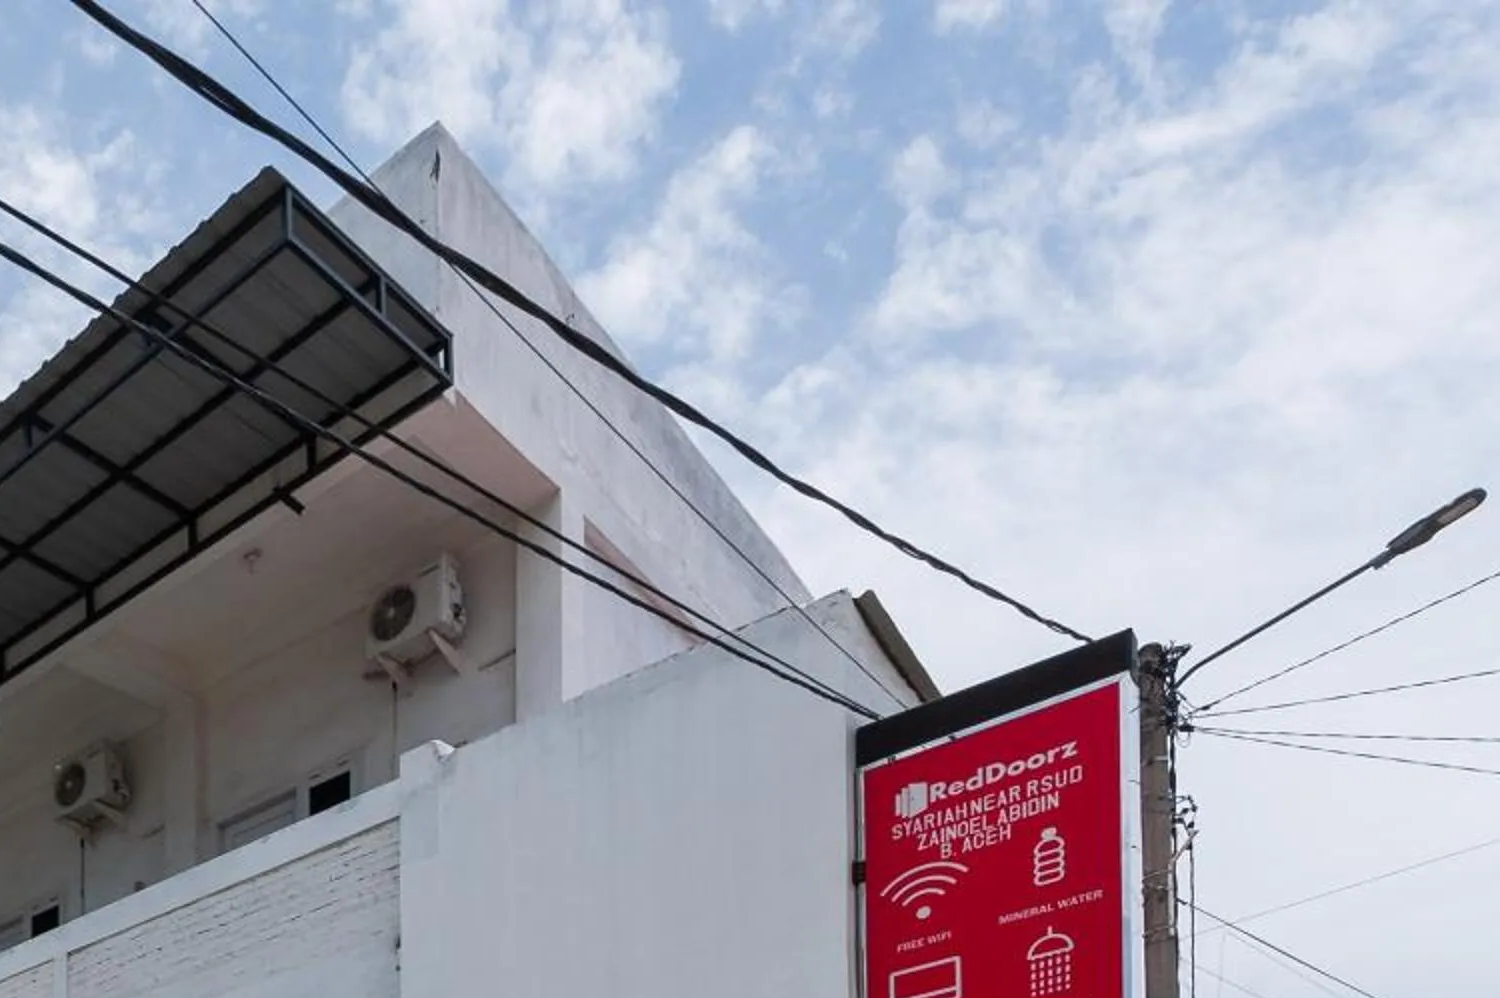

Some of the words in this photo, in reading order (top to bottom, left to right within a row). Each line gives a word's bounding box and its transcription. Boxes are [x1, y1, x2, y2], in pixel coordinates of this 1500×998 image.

[929, 740, 1078, 802] RedDoorz
[891, 802, 969, 840] SYARIAH
[970, 785, 1022, 817] NEAR
[1027, 765, 1084, 799] RSUD
[917, 815, 993, 851] ZAINOEL
[997, 791, 1061, 828] ABIDIN
[962, 825, 1012, 854] ACEH
[998, 904, 1055, 925] MINERAL
[1057, 889, 1104, 910] WATER
[897, 938, 925, 953] FREE
[927, 930, 952, 945] WIFI
